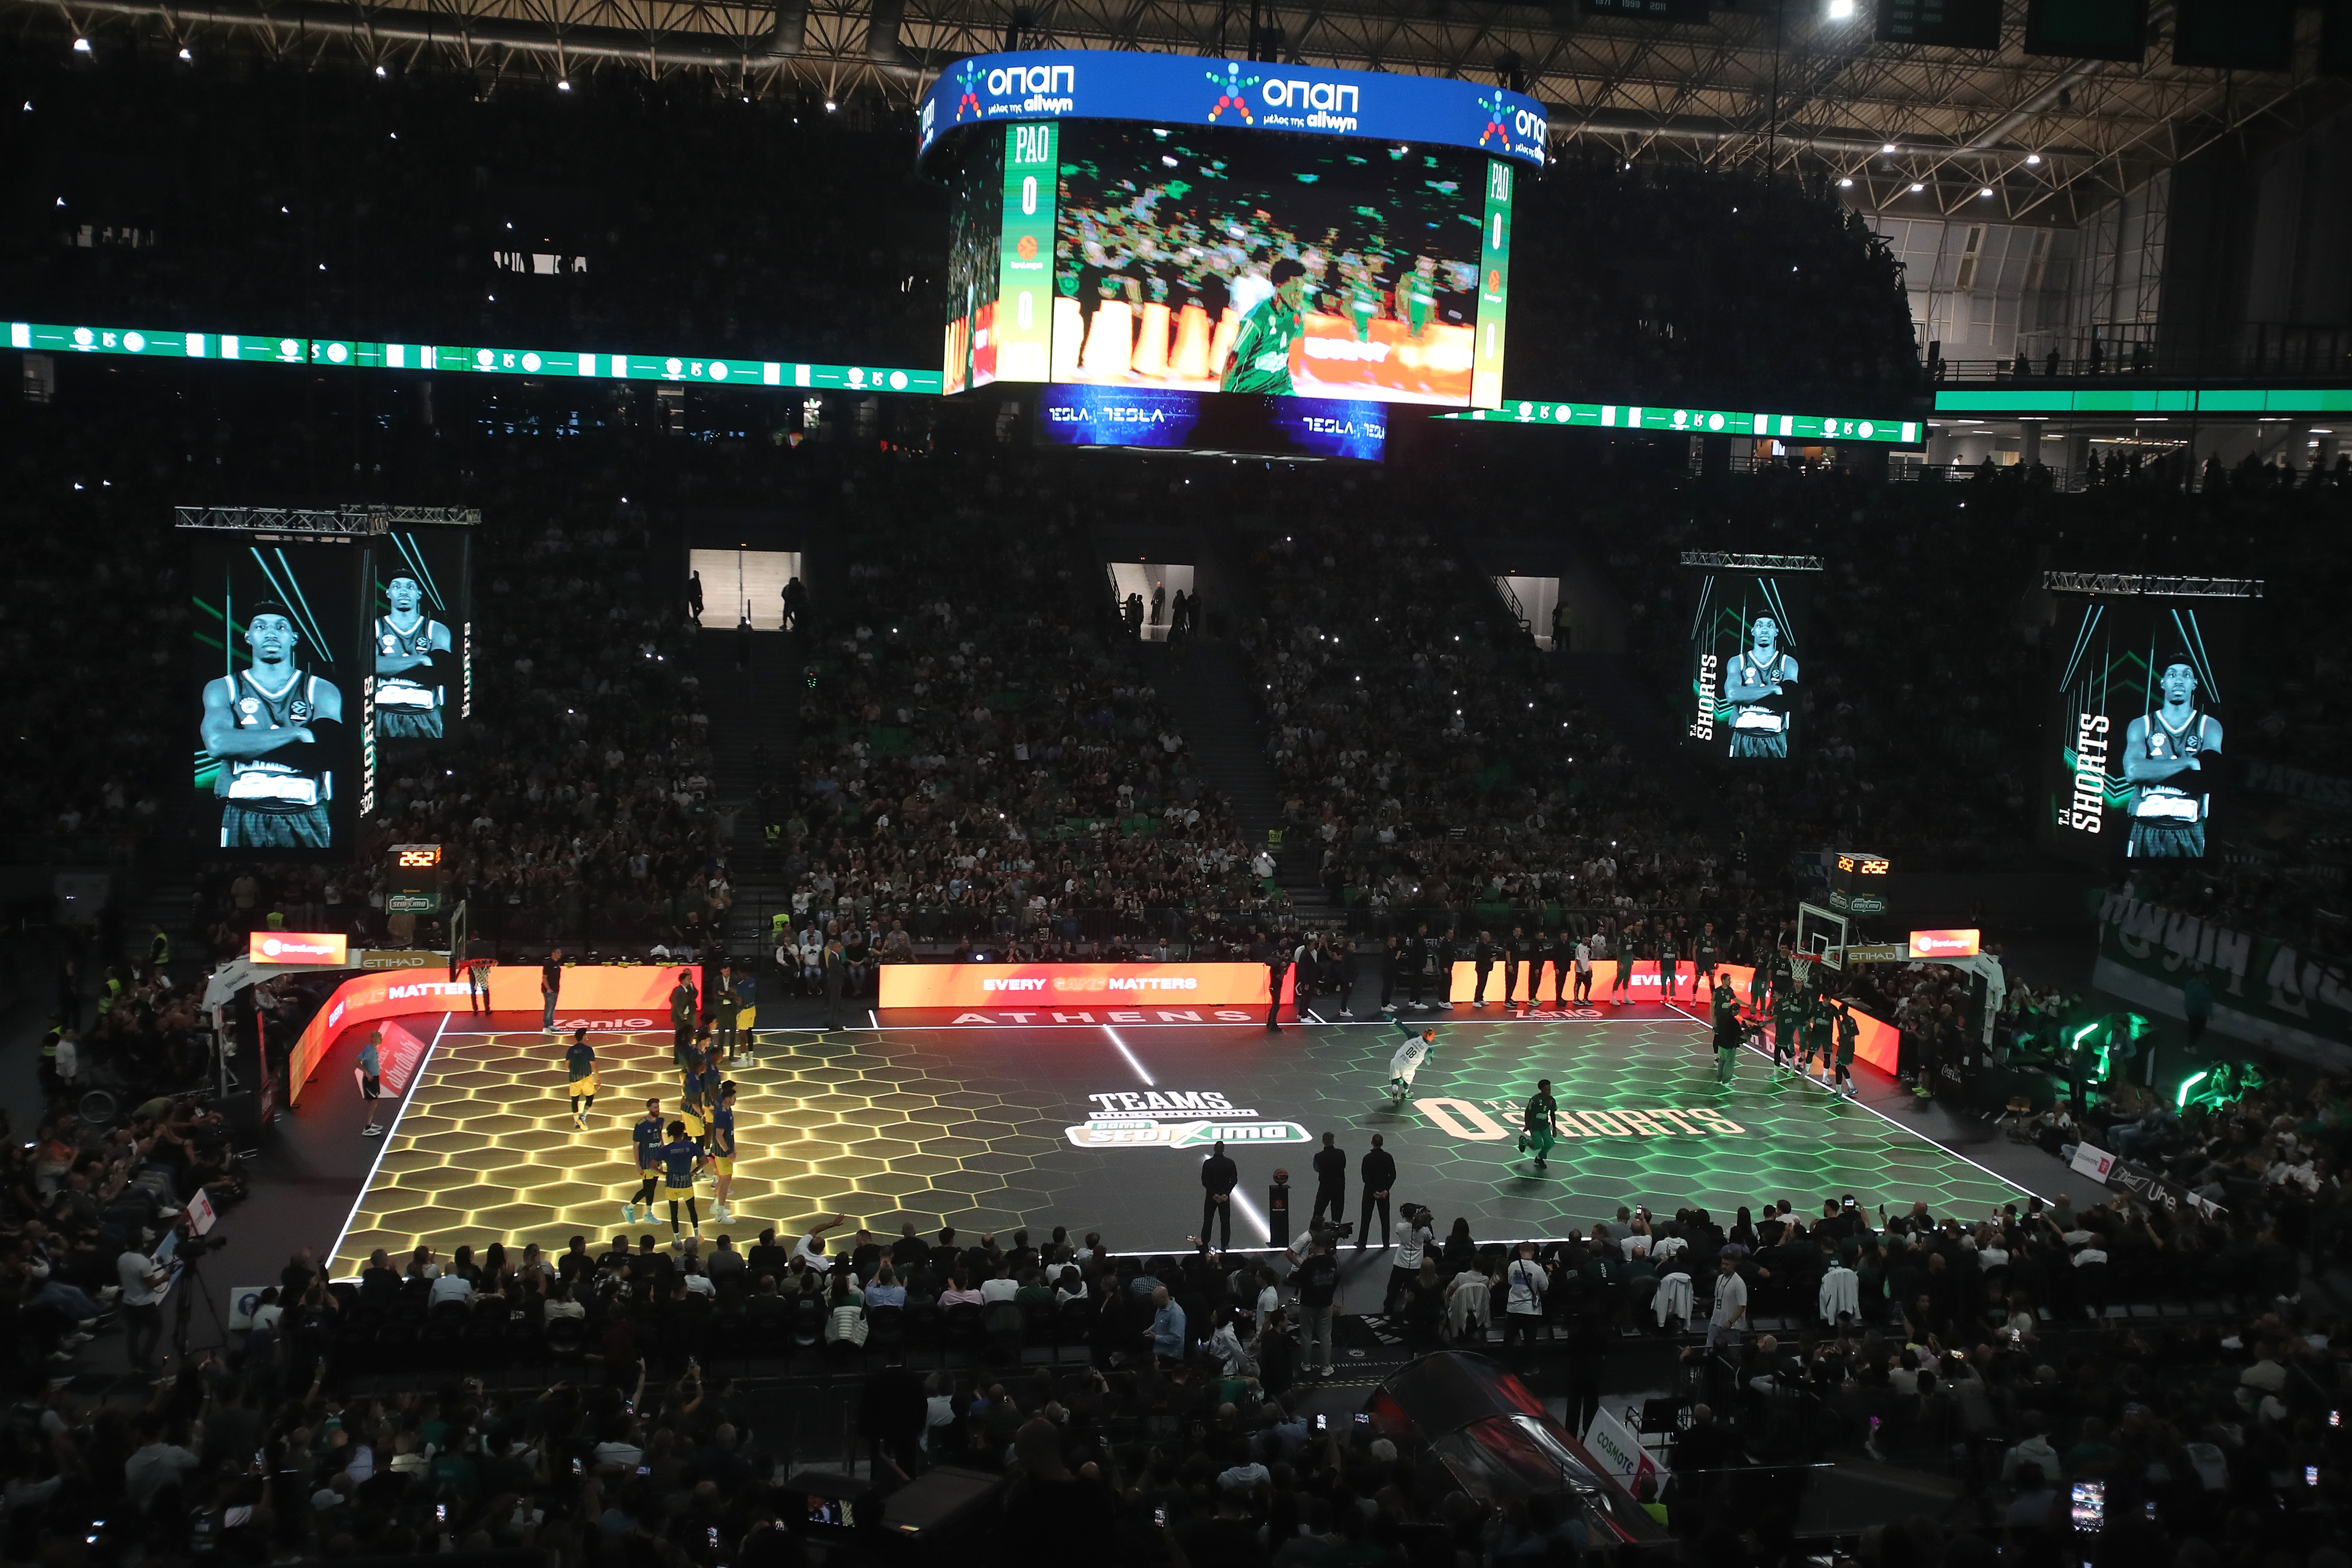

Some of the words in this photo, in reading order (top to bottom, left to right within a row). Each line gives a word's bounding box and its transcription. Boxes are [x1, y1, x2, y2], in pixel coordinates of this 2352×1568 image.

[1024, 94, 1073, 115] allwyn
[1306, 111, 1357, 133] allwyn
[1015, 126, 1048, 164] PAO
[1491, 163, 1509, 201] PAO
[1022, 176, 1038, 215] 0
[1492, 213, 1502, 250] 0
[1049, 407, 1089, 421] TESLA
[1103, 407, 1165, 423] TESLA
[1303, 417, 1354, 435] TESLA
[1697, 654, 1717, 741] SHORTS
[364, 675, 374, 814] SHORTS
[2072, 713, 2111, 834] SHORTS
[2058, 807, 2071, 826] T.J.
[363, 957, 424, 968] ETIHAD
[1849, 952, 1895, 960] ETIHAD
[983, 979, 1047, 991] EVERY
[1109, 978, 1198, 990] MATTERS
[951, 1011, 1253, 1025] ATHENS
[1089, 1090, 1233, 1112] TEAMS
[1412, 1098, 1510, 1141] 0
[1597, 1432, 1634, 1475] COSMOTE
